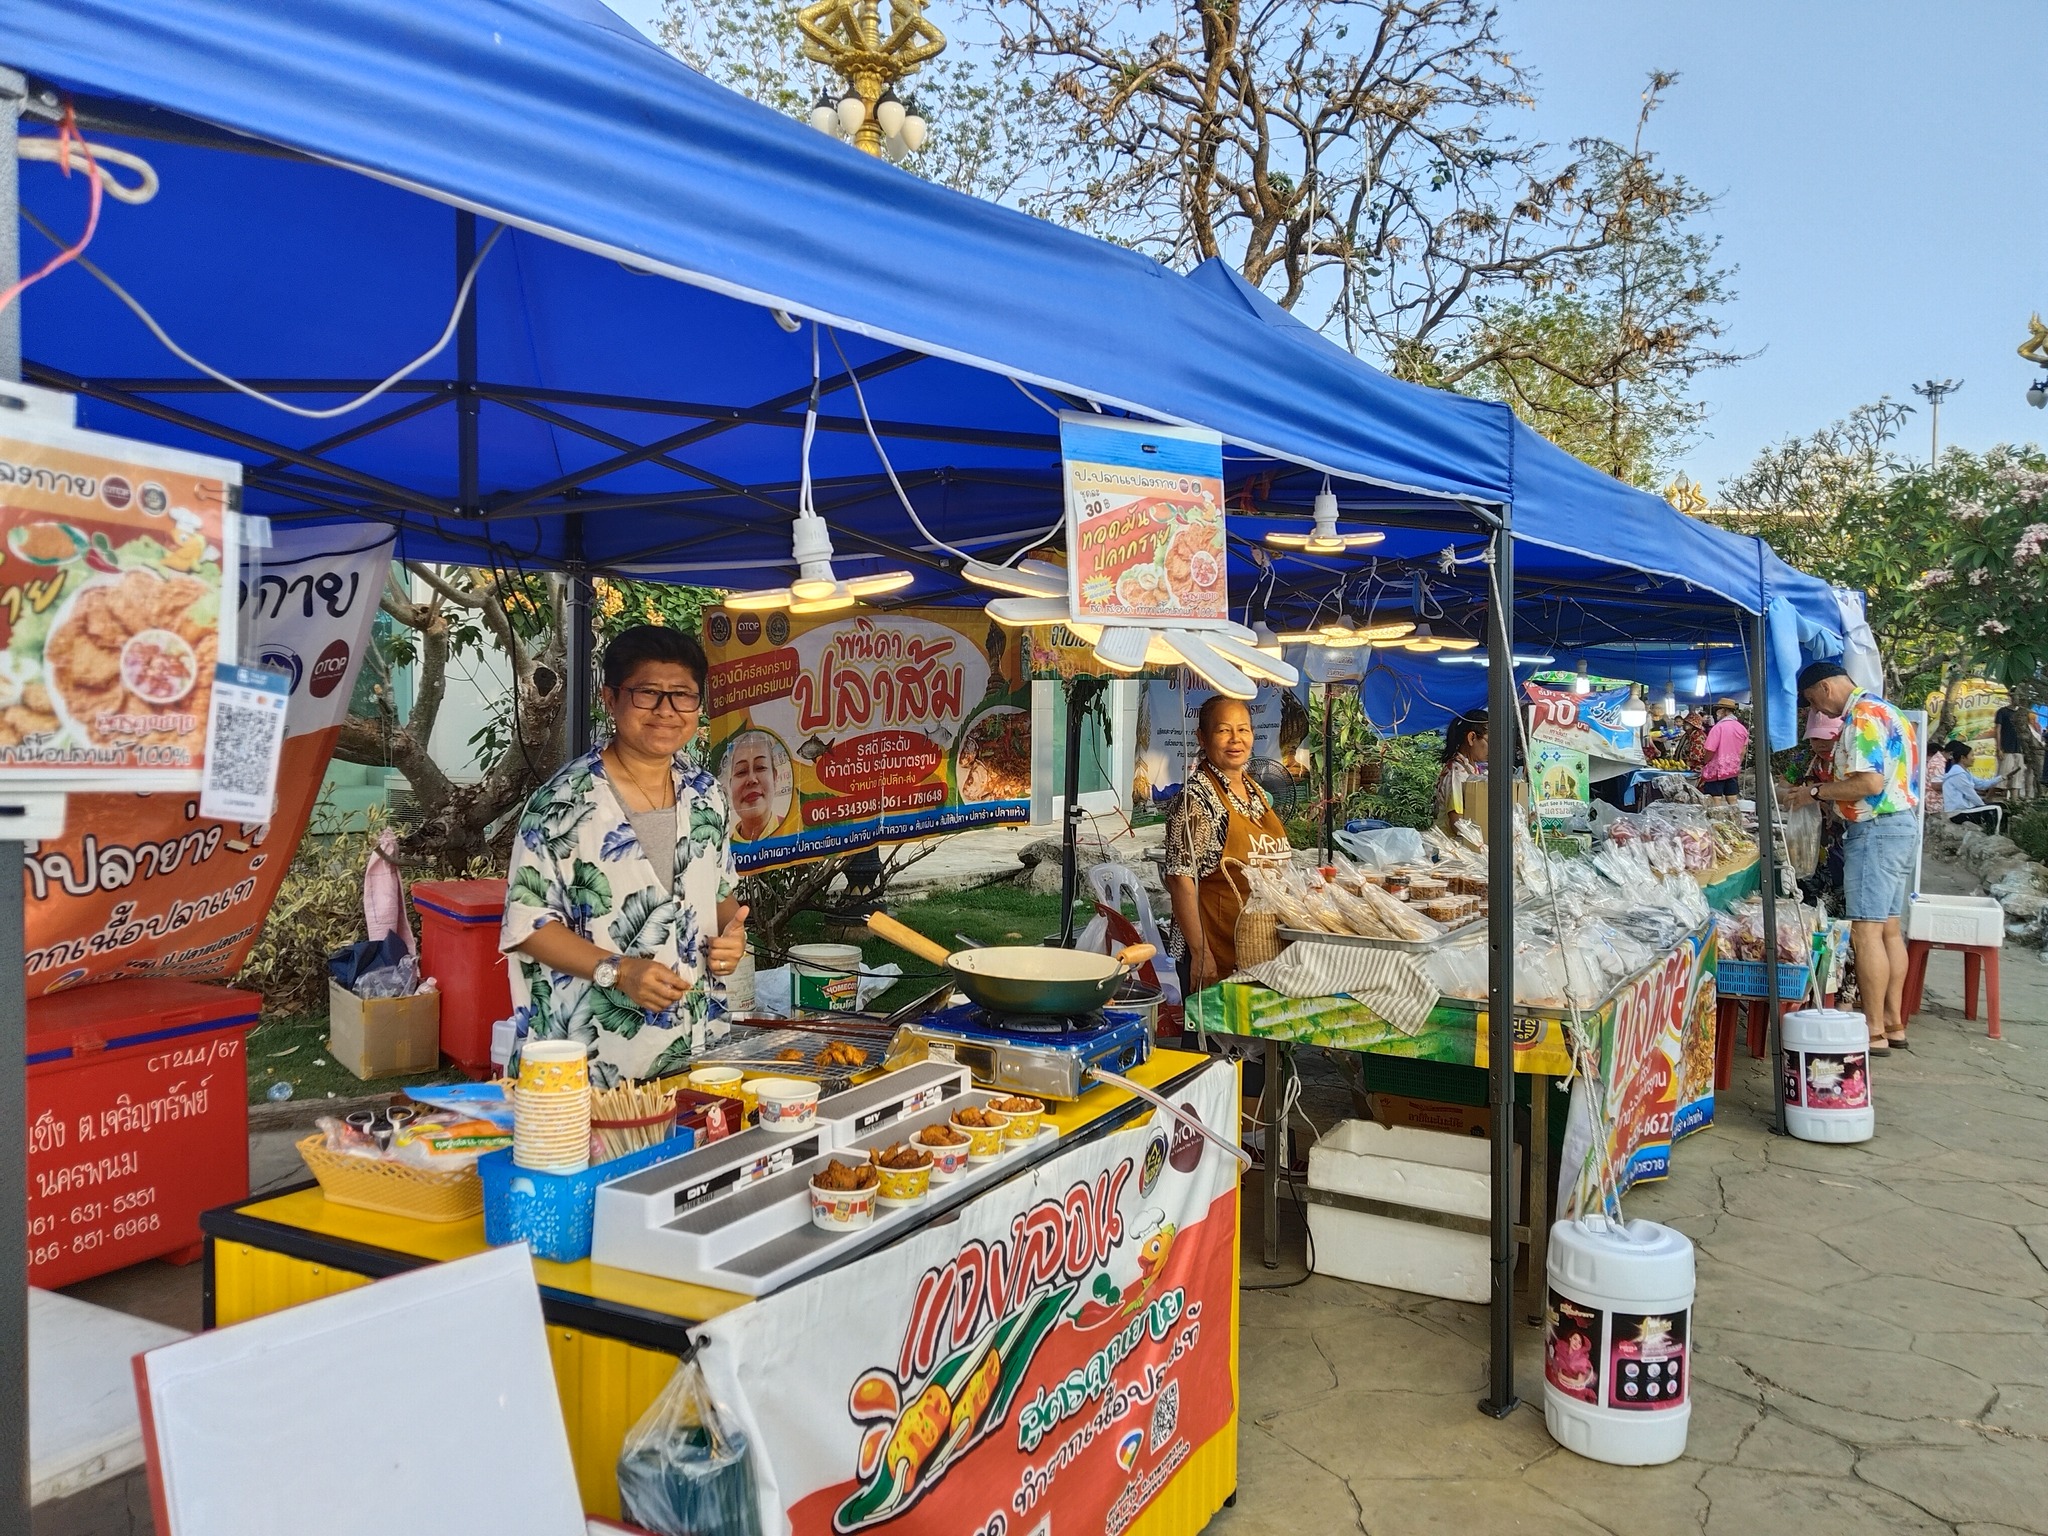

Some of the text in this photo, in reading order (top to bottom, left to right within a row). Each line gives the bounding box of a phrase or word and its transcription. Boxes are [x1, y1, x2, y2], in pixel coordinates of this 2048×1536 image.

[1085, 500, 1102, 517] 30
[738, 622, 760, 631] OTOP
[314, 655, 347, 676] OTOP
[792, 638, 964, 732] ปลาส้ม
[134, 746, 192, 765] 100%
[147, 1040, 239, 1072] CT244/67
[863, 1111, 881, 1127] DIY
[27, 1151, 138, 1201] .นครพนม
[686, 1182, 710, 1201] DIY
